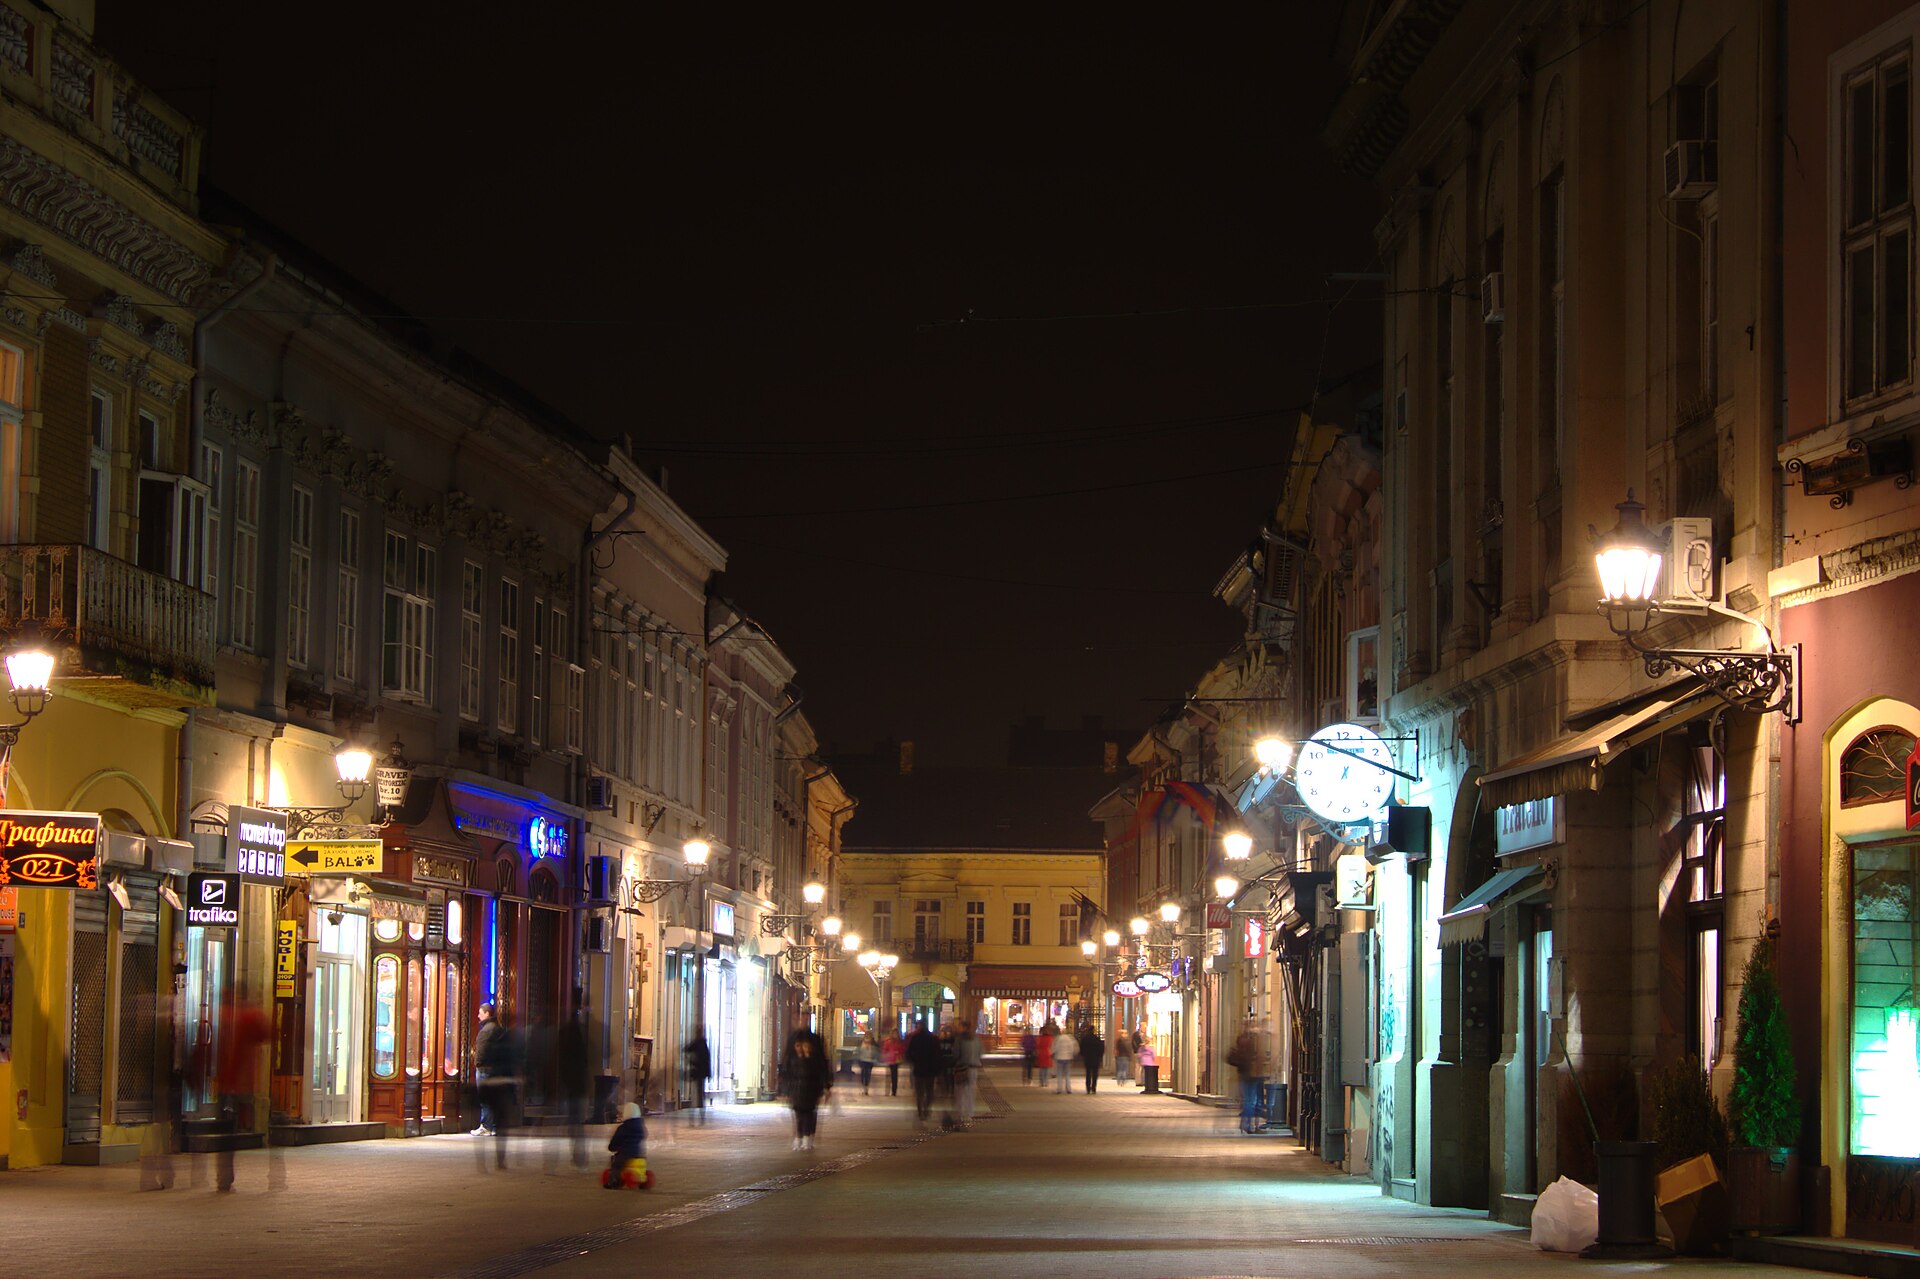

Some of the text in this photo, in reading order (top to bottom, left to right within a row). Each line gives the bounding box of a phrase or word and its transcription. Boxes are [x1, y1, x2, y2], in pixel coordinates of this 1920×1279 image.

[0, 819, 96, 848] Трафика
[22, 859, 65, 877] 021
[189, 906, 238, 923] trafika
[1209, 909, 1230, 926] illy
[278, 929, 293, 973] MOBIL
